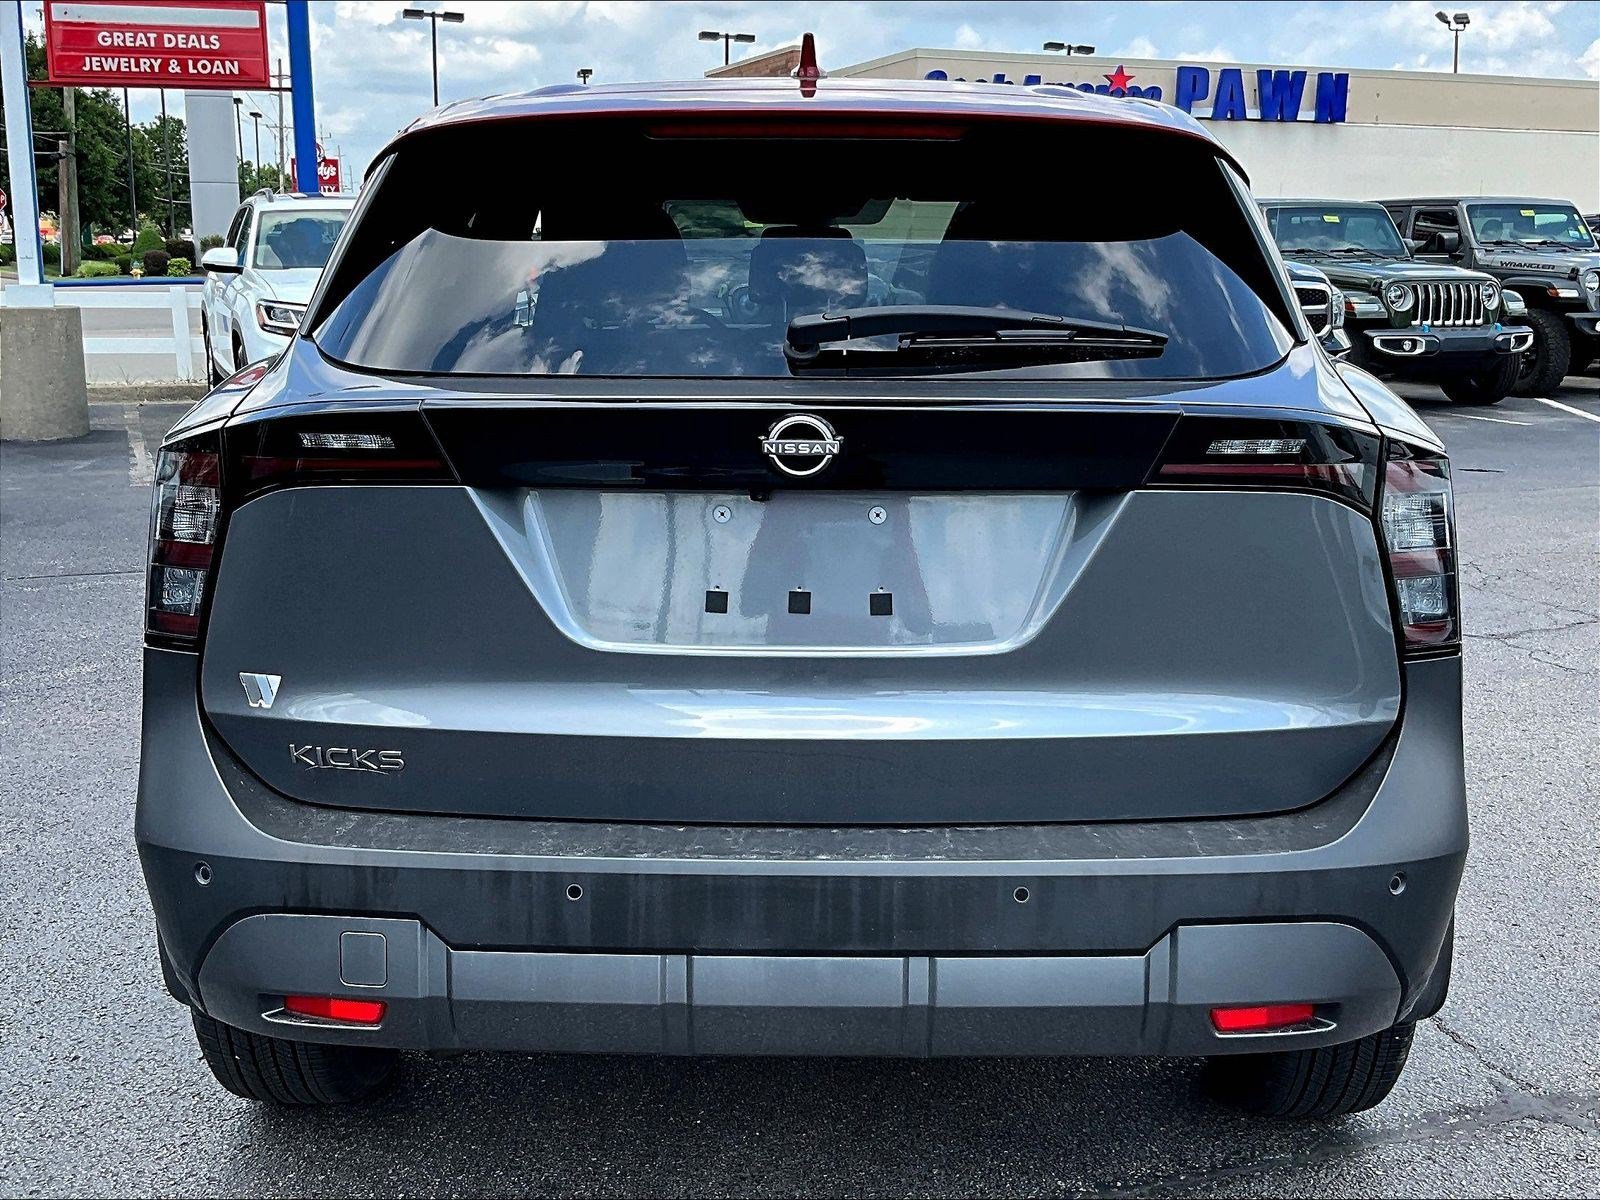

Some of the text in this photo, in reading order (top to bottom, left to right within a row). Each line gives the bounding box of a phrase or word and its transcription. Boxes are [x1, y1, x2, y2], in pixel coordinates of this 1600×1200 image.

[97, 31, 220, 50] GREAT DEALS
[82, 56, 240, 75] JEWELRY & LOAN
[1175, 66, 1349, 123] PAWN
[1500, 260, 1556, 270] WRANGLER
[763, 443, 838, 454] NISSAN
[289, 743, 405, 772] KICKS
